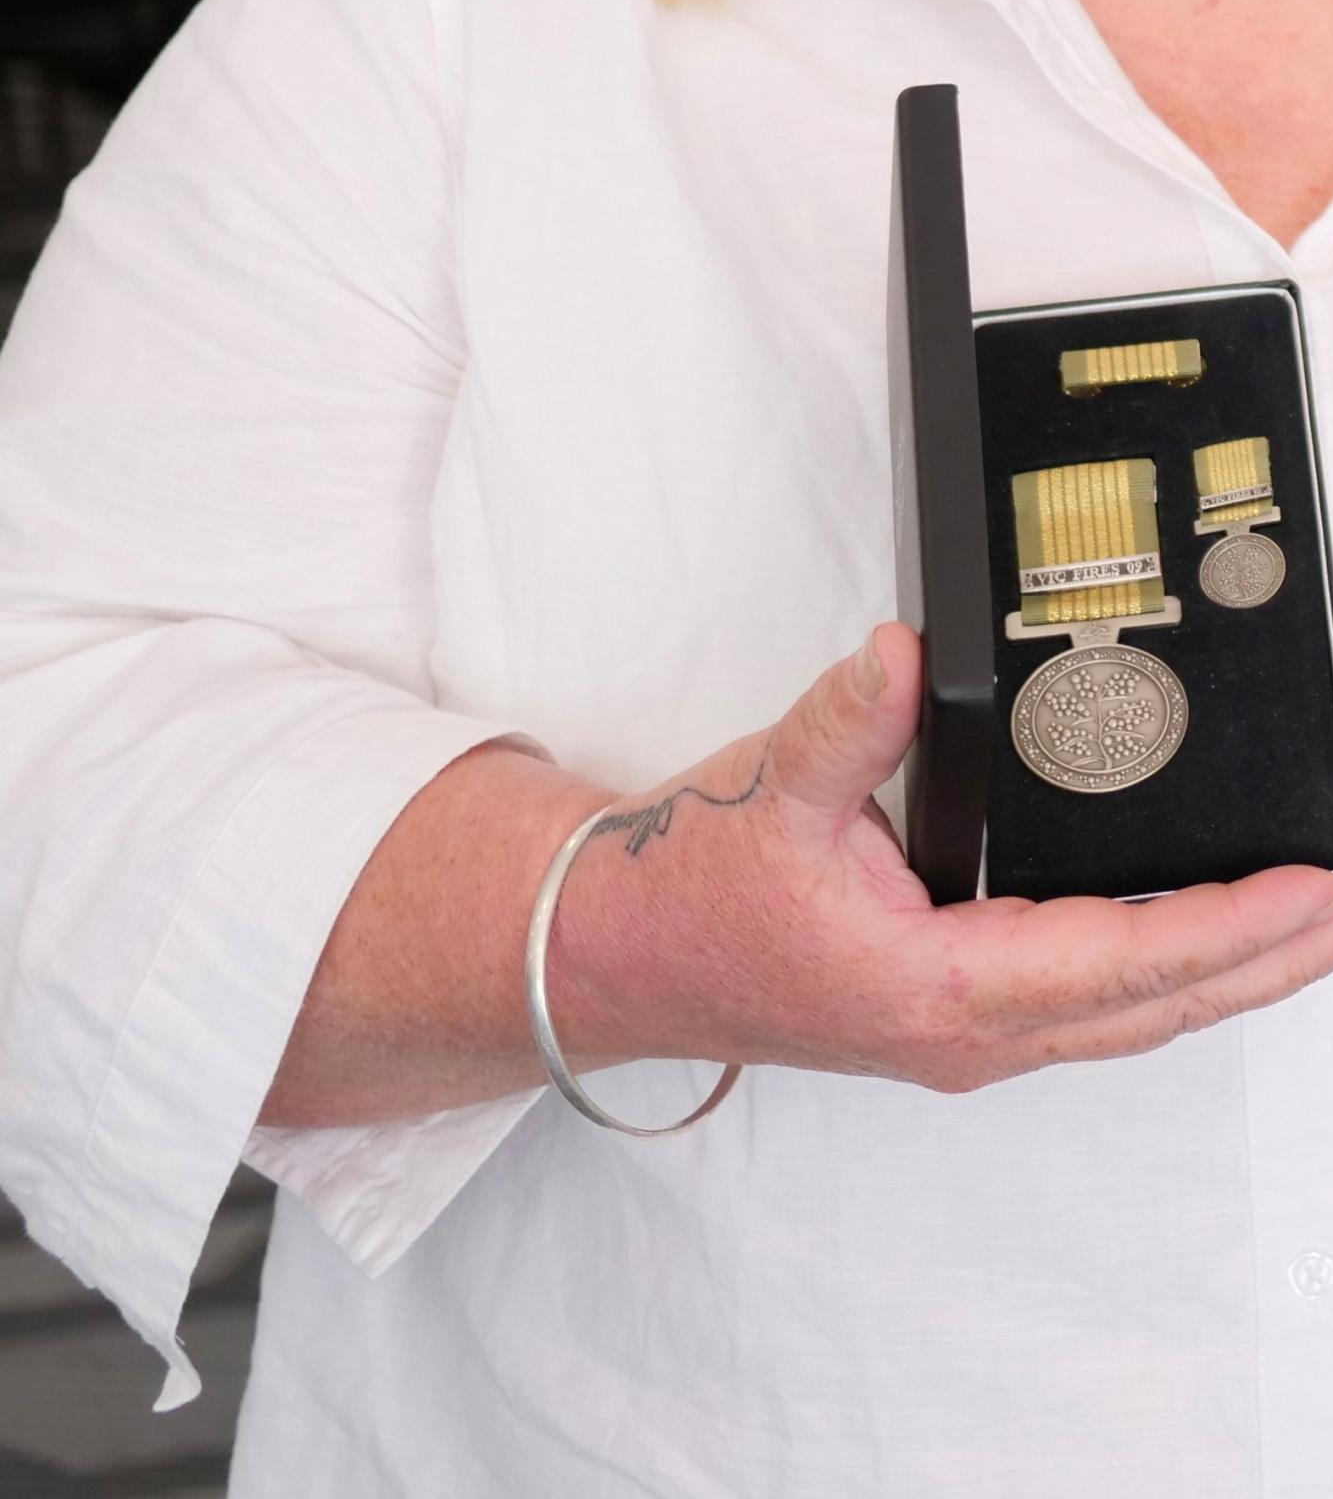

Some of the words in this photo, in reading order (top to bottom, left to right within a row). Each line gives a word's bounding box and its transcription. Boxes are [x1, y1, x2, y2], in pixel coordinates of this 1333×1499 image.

[1037, 572, 1066, 587] VIC
[1072, 563, 1119, 581] FIRES
[1126, 560, 1142, 575] 09
